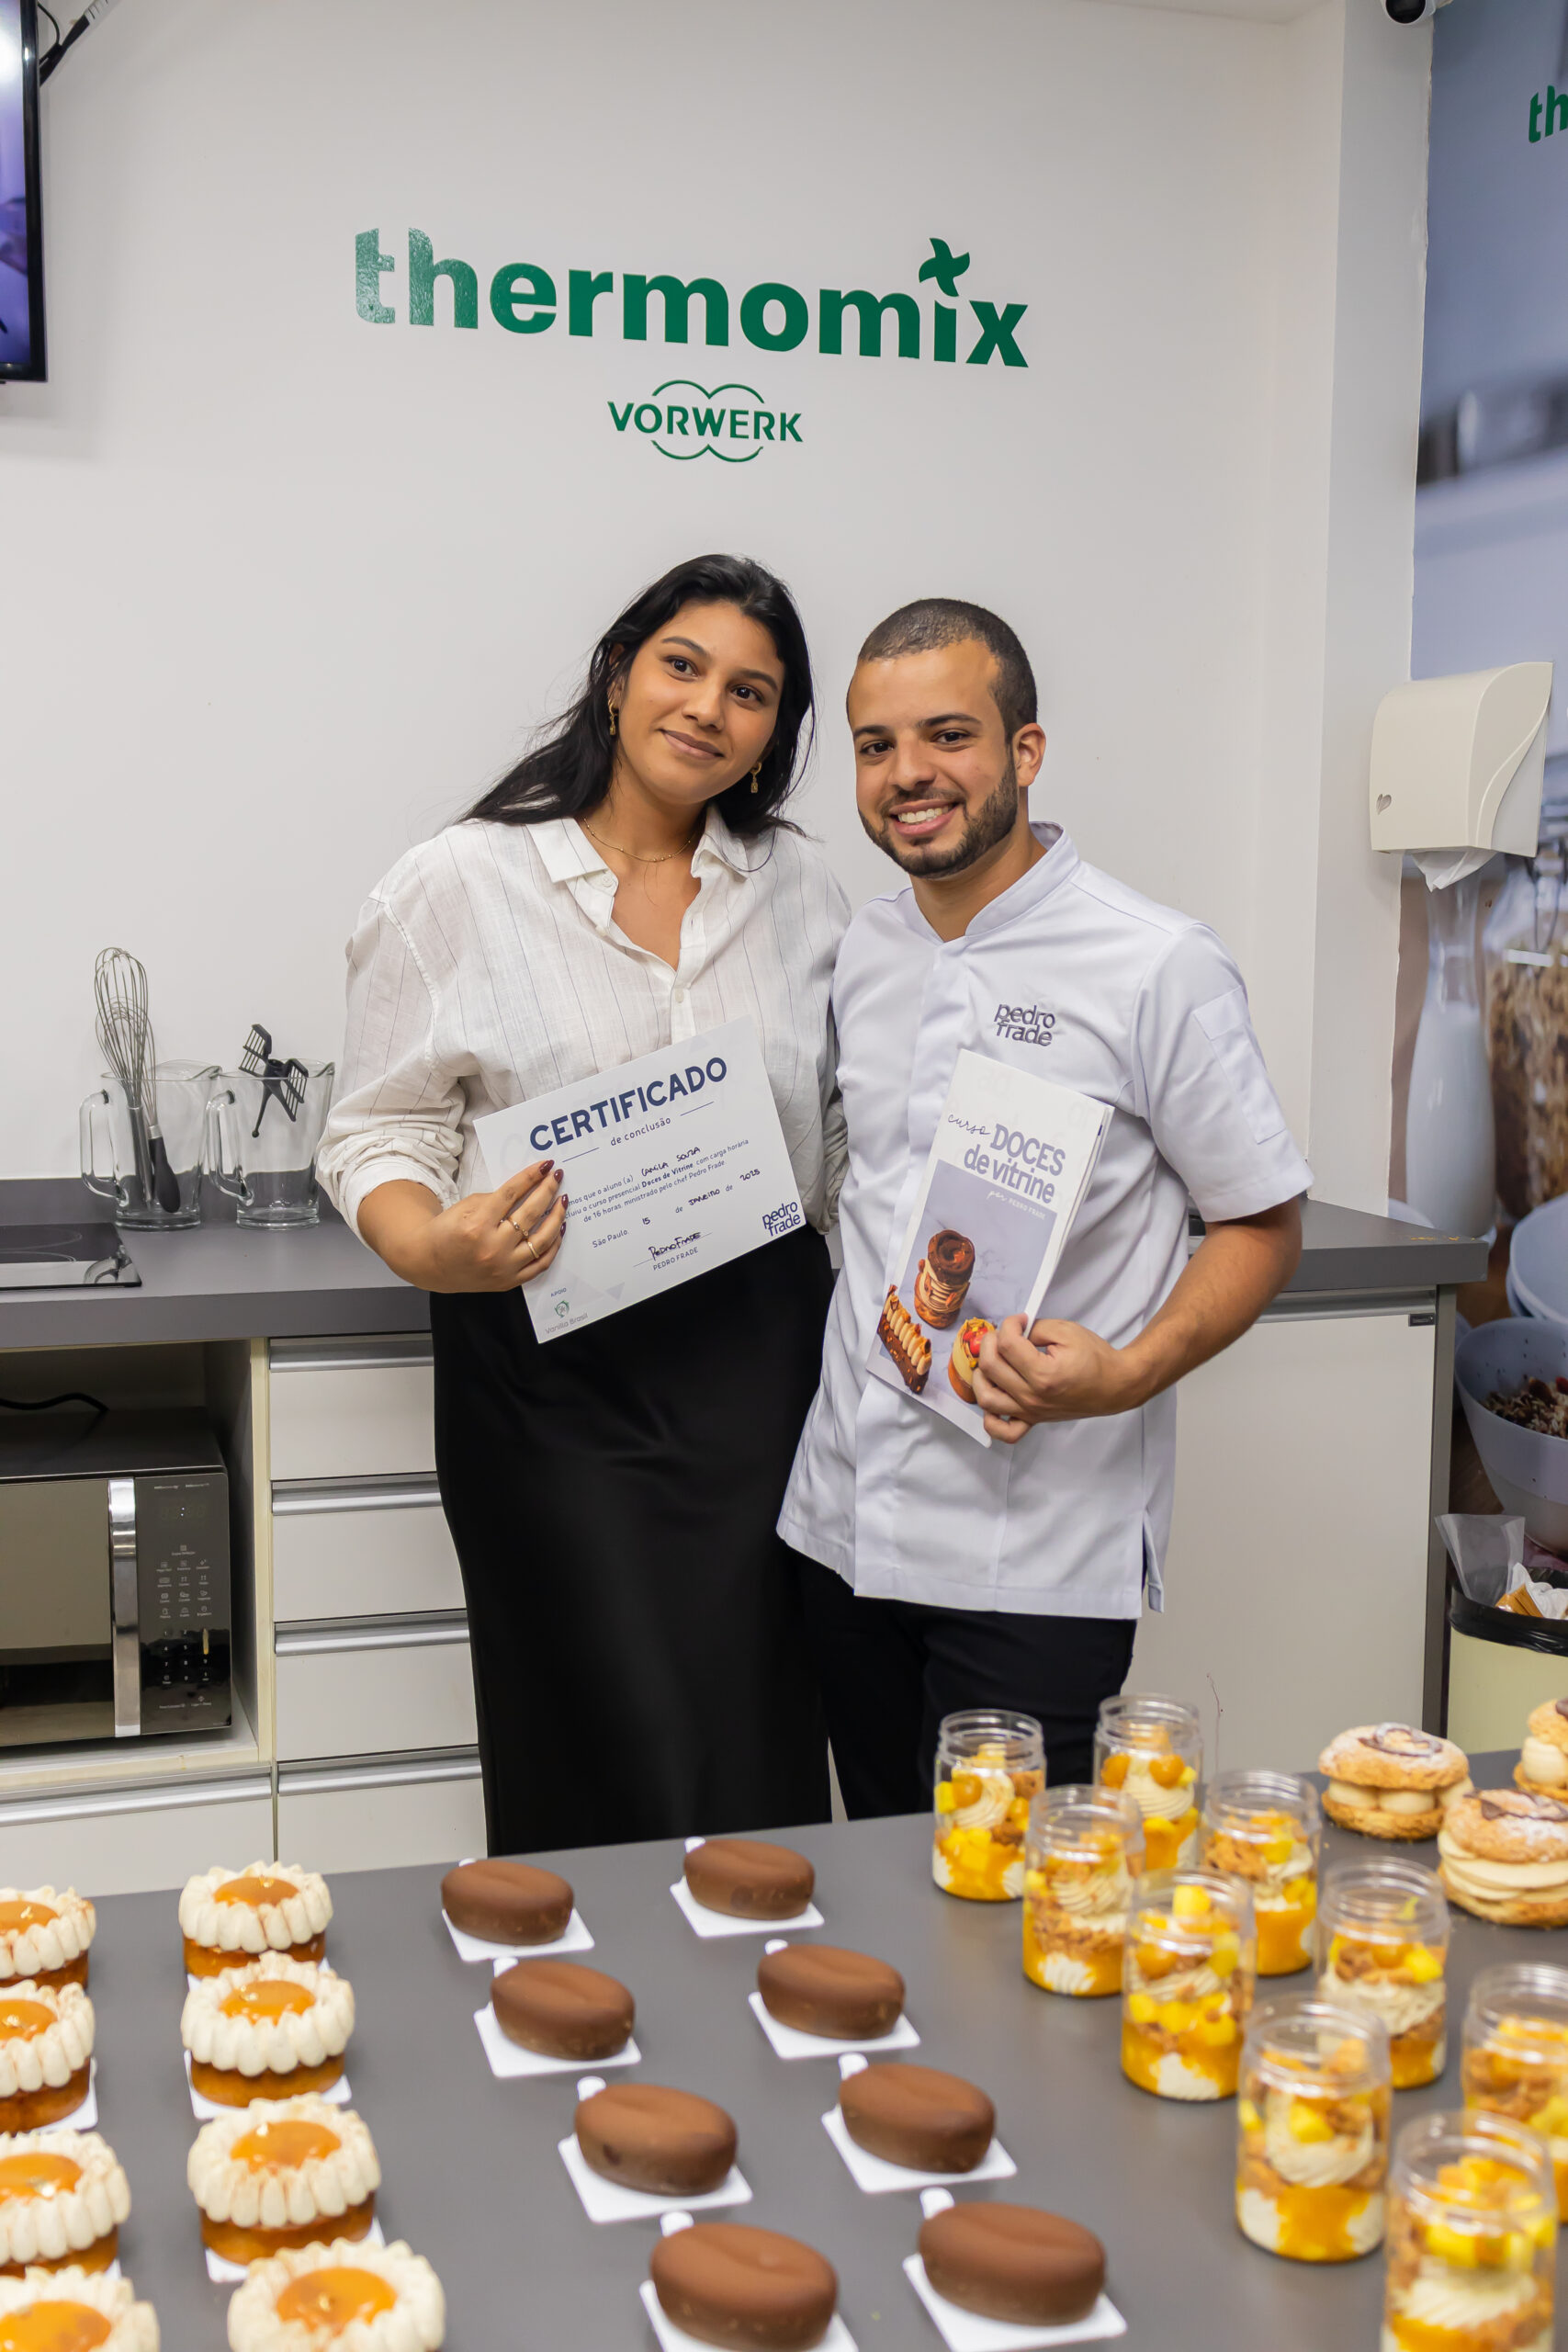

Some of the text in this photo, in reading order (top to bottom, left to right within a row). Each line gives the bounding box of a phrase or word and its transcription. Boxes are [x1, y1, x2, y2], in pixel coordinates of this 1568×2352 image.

[355, 227, 1029, 368] thermomix
[607, 401, 804, 443] VORWERK
[994, 1004, 1055, 1029] pedro
[530, 1057, 727, 1151] CERTIFICADO
[610, 1117, 671, 1146] de conclusão
[989, 1123, 1066, 1176] DOCES
[583, 1191, 596, 1201] que
[603, 1181, 623, 1193] aluno
[623, 1174, 634, 1185] (a)
[588, 1198, 607, 1209] curso
[607, 1183, 641, 1203] presencial
[641, 1176, 661, 1188] Doces
[662, 1171, 671, 1180] de
[671, 1162, 694, 1175] Vitrine
[695, 1157, 709, 1166] com
[709, 1149, 727, 1159] carga
[739, 1169, 761, 1181] 2025
[964, 1144, 1055, 1204] de vitrine
[583, 1214, 592, 1223] de
[592, 1210, 602, 1218] 16
[624, 1186, 659, 1206] ministrado
[659, 1182, 672, 1193] pelo
[688, 1167, 707, 1179] Pedro
[641, 1216, 651, 1225] 15
[675, 1205, 683, 1214] de
[761, 1201, 798, 1229] pedro
[767, 1214, 801, 1237] frade
[592, 1238, 606, 1248] São
[653, 1247, 699, 1271] PEDRO FRADE
